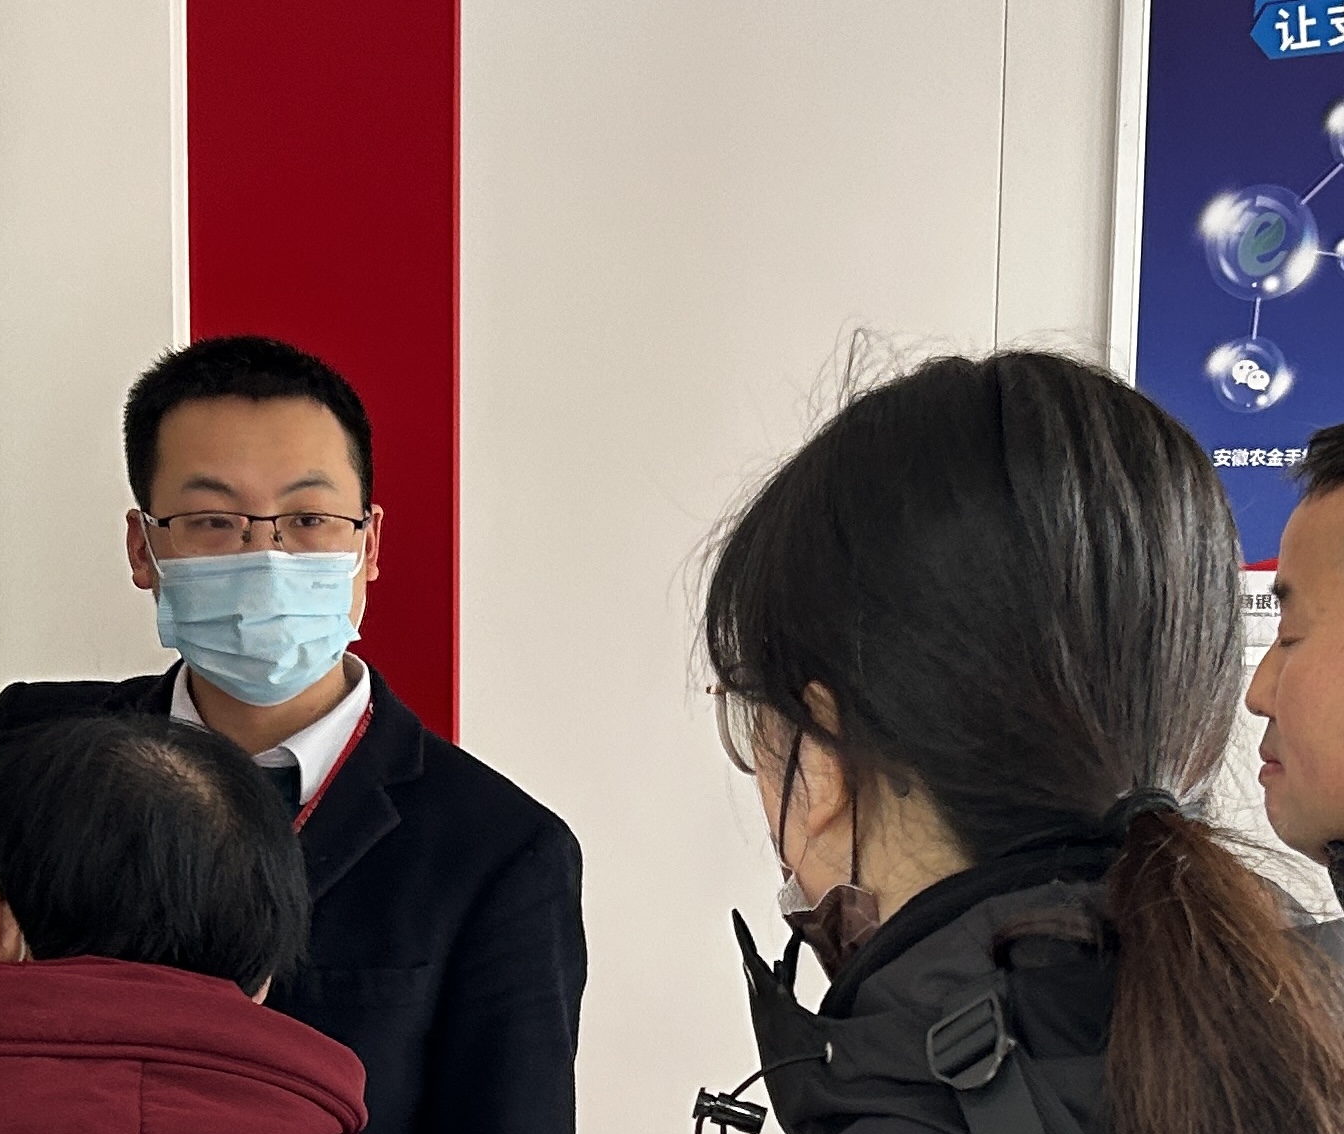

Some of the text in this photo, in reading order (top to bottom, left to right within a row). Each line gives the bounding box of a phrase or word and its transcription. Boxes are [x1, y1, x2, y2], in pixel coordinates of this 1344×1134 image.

[1213, 448, 1309, 467] 安徽农金手
